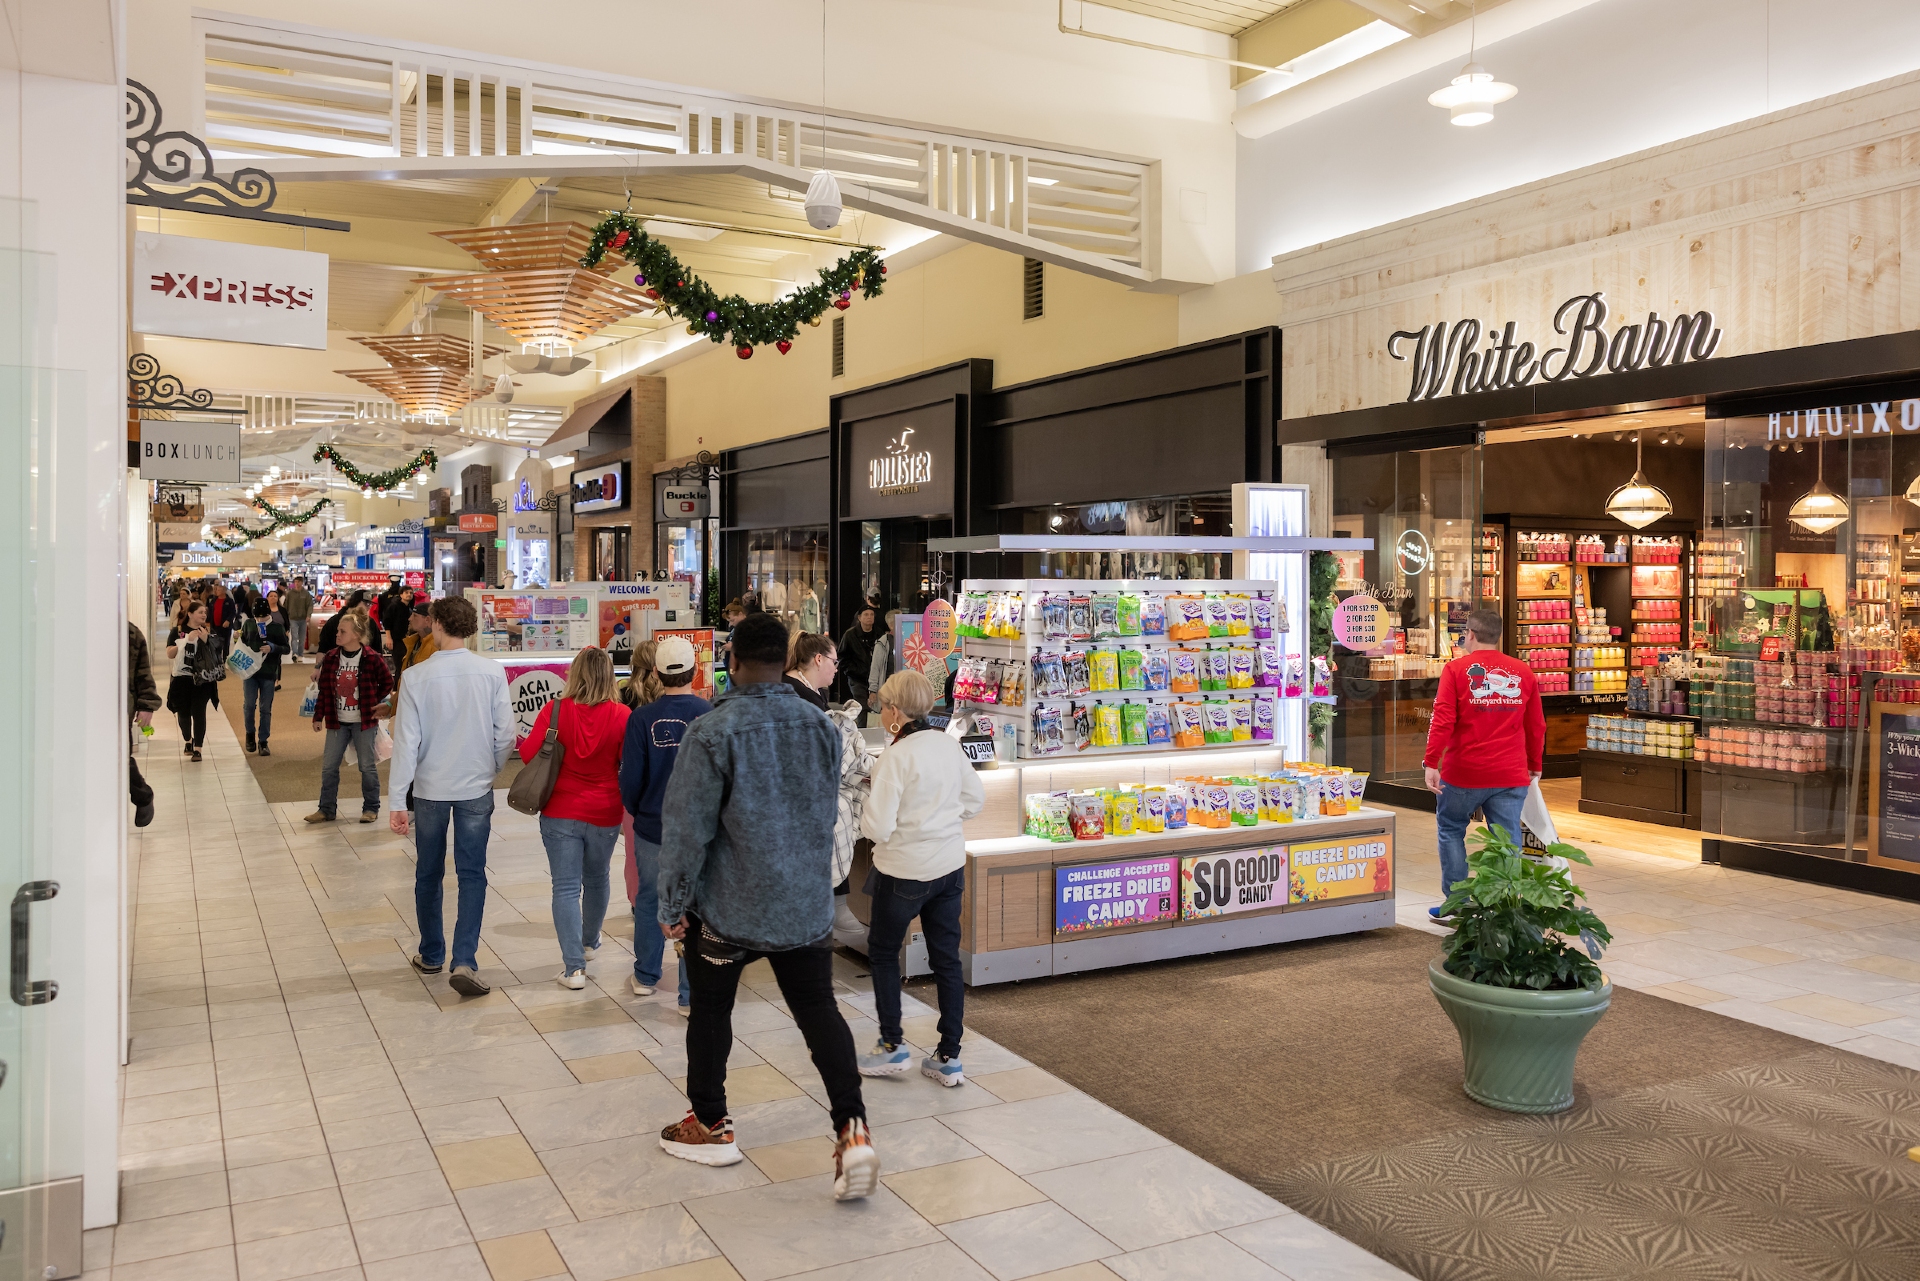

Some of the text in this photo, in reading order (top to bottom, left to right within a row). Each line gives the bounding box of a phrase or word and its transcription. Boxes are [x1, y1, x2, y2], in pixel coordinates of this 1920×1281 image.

[150, 271, 313, 312] EXPRESS
[1388, 292, 1723, 402] White Barn
[145, 442, 236, 461] BOXLUNCH
[869, 450, 932, 489] HOLLISTER
[569, 478, 603, 504] Buckle
[666, 491, 708, 500] Buckle
[181, 552, 222, 564] Dillard's
[609, 586, 651, 594] WELCOME
[1382, 581, 1414, 599] Barn
[622, 603, 639, 611] SUPER
[1346, 615, 1351, 623] 2
[1364, 614, 1376, 622] $20
[1346, 625, 1351, 633] 3
[1346, 635, 1376, 643] 4 FOR $40
[230, 655, 250, 671] BELOW
[234, 649, 254, 665] five
[519, 680, 550, 698] ACAI
[1469, 697, 1502, 706] vineyard
[1580, 695, 1592, 703] The
[1593, 694, 1615, 703] World's
[1887, 731, 1901, 741] Why
[1294, 842, 1386, 867] FREEZE DRIED
[1067, 862, 1170, 883] CHALLENGE ACCEPTED
[1316, 861, 1368, 883] CANDY
[1062, 876, 1172, 904] FREEZE DRIED
[1194, 853, 1280, 910] SO GOOD
[1238, 884, 1274, 905] CANDY
[1087, 898, 1149, 921] CANDY
